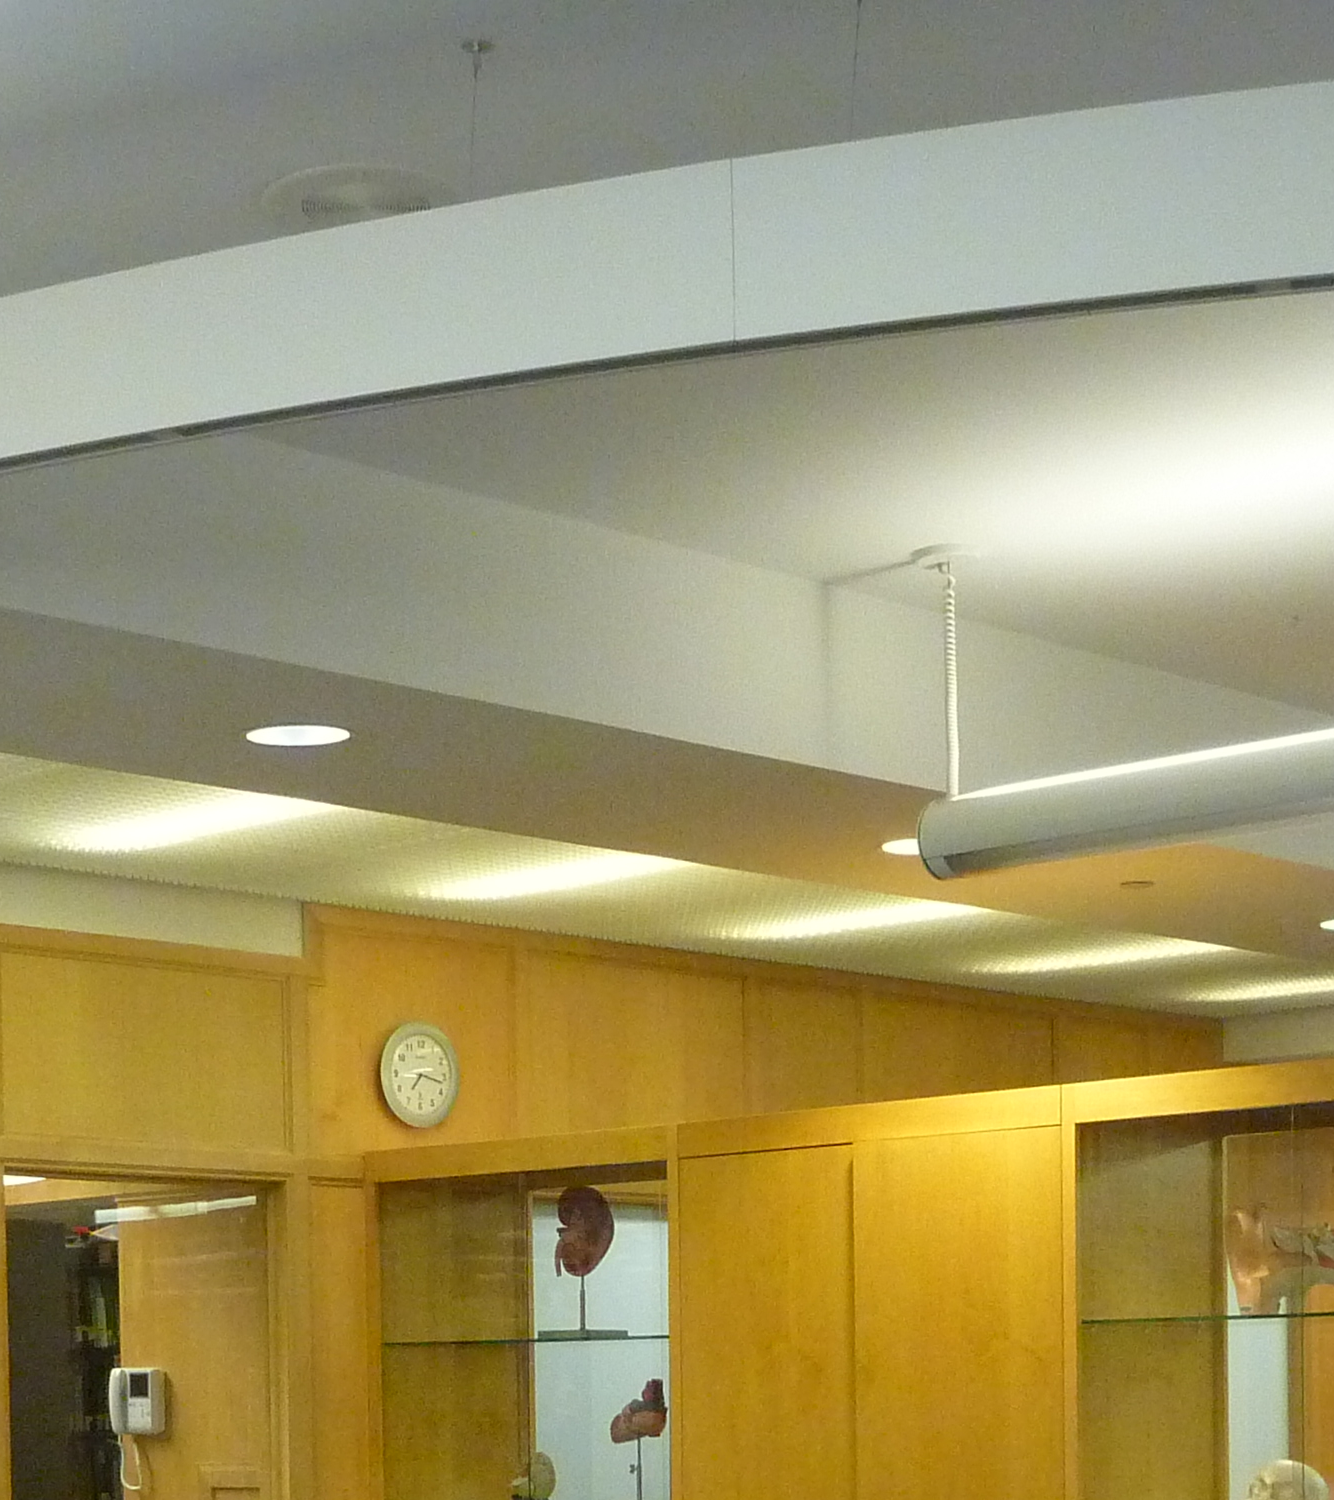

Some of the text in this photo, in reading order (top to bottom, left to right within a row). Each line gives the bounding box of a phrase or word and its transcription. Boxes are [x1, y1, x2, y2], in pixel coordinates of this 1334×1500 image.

[406, 1043, 413, 1052] 11
[417, 1040, 425, 1049] 12
[398, 1053, 405, 1062] 10
